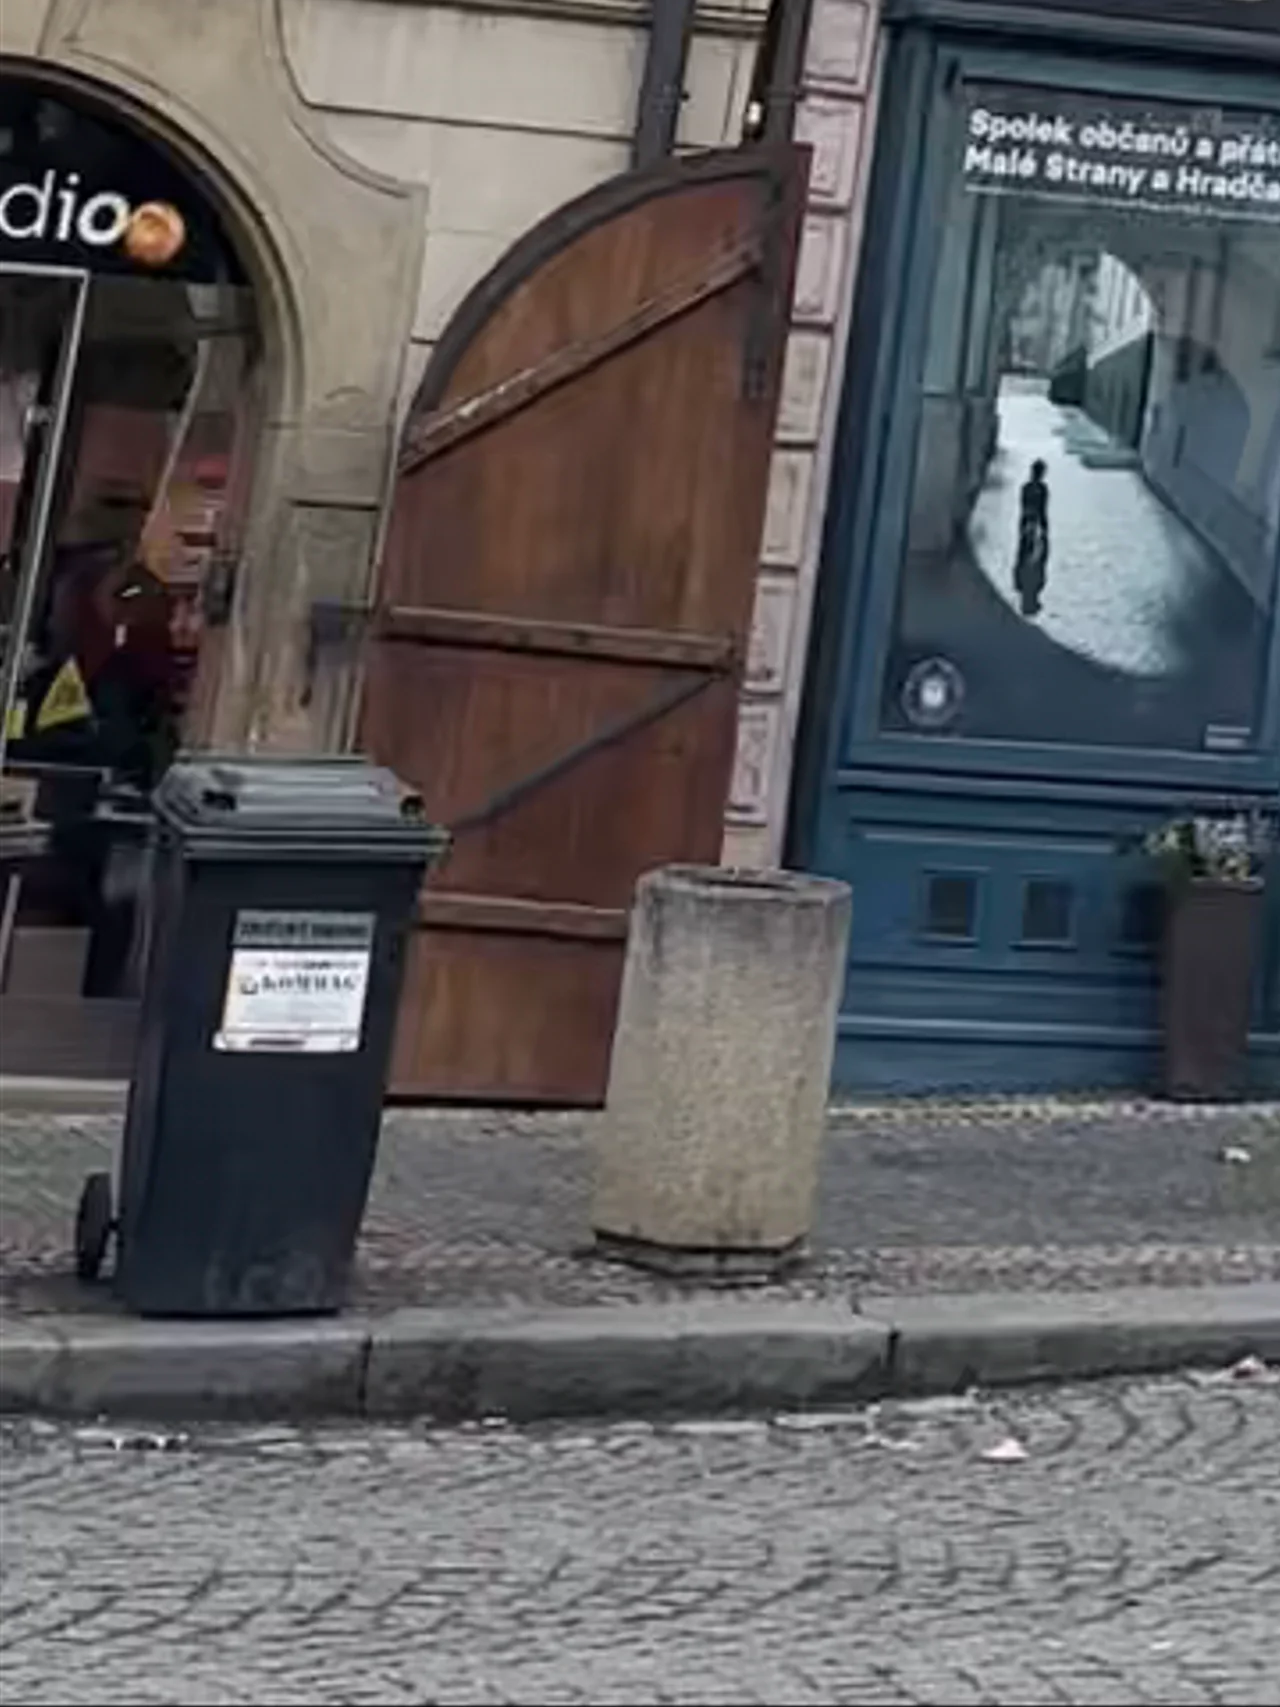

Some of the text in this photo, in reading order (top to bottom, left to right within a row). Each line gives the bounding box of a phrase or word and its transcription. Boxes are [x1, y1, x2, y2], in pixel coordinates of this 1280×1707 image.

[970, 109, 1073, 145] Spolek
[1079, 122, 1190, 156] občanů
[1195, 137, 1213, 158] a
[964, 145, 1038, 177] Malé
[1045, 153, 1148, 194] Strany
[1151, 167, 1170, 190] a
